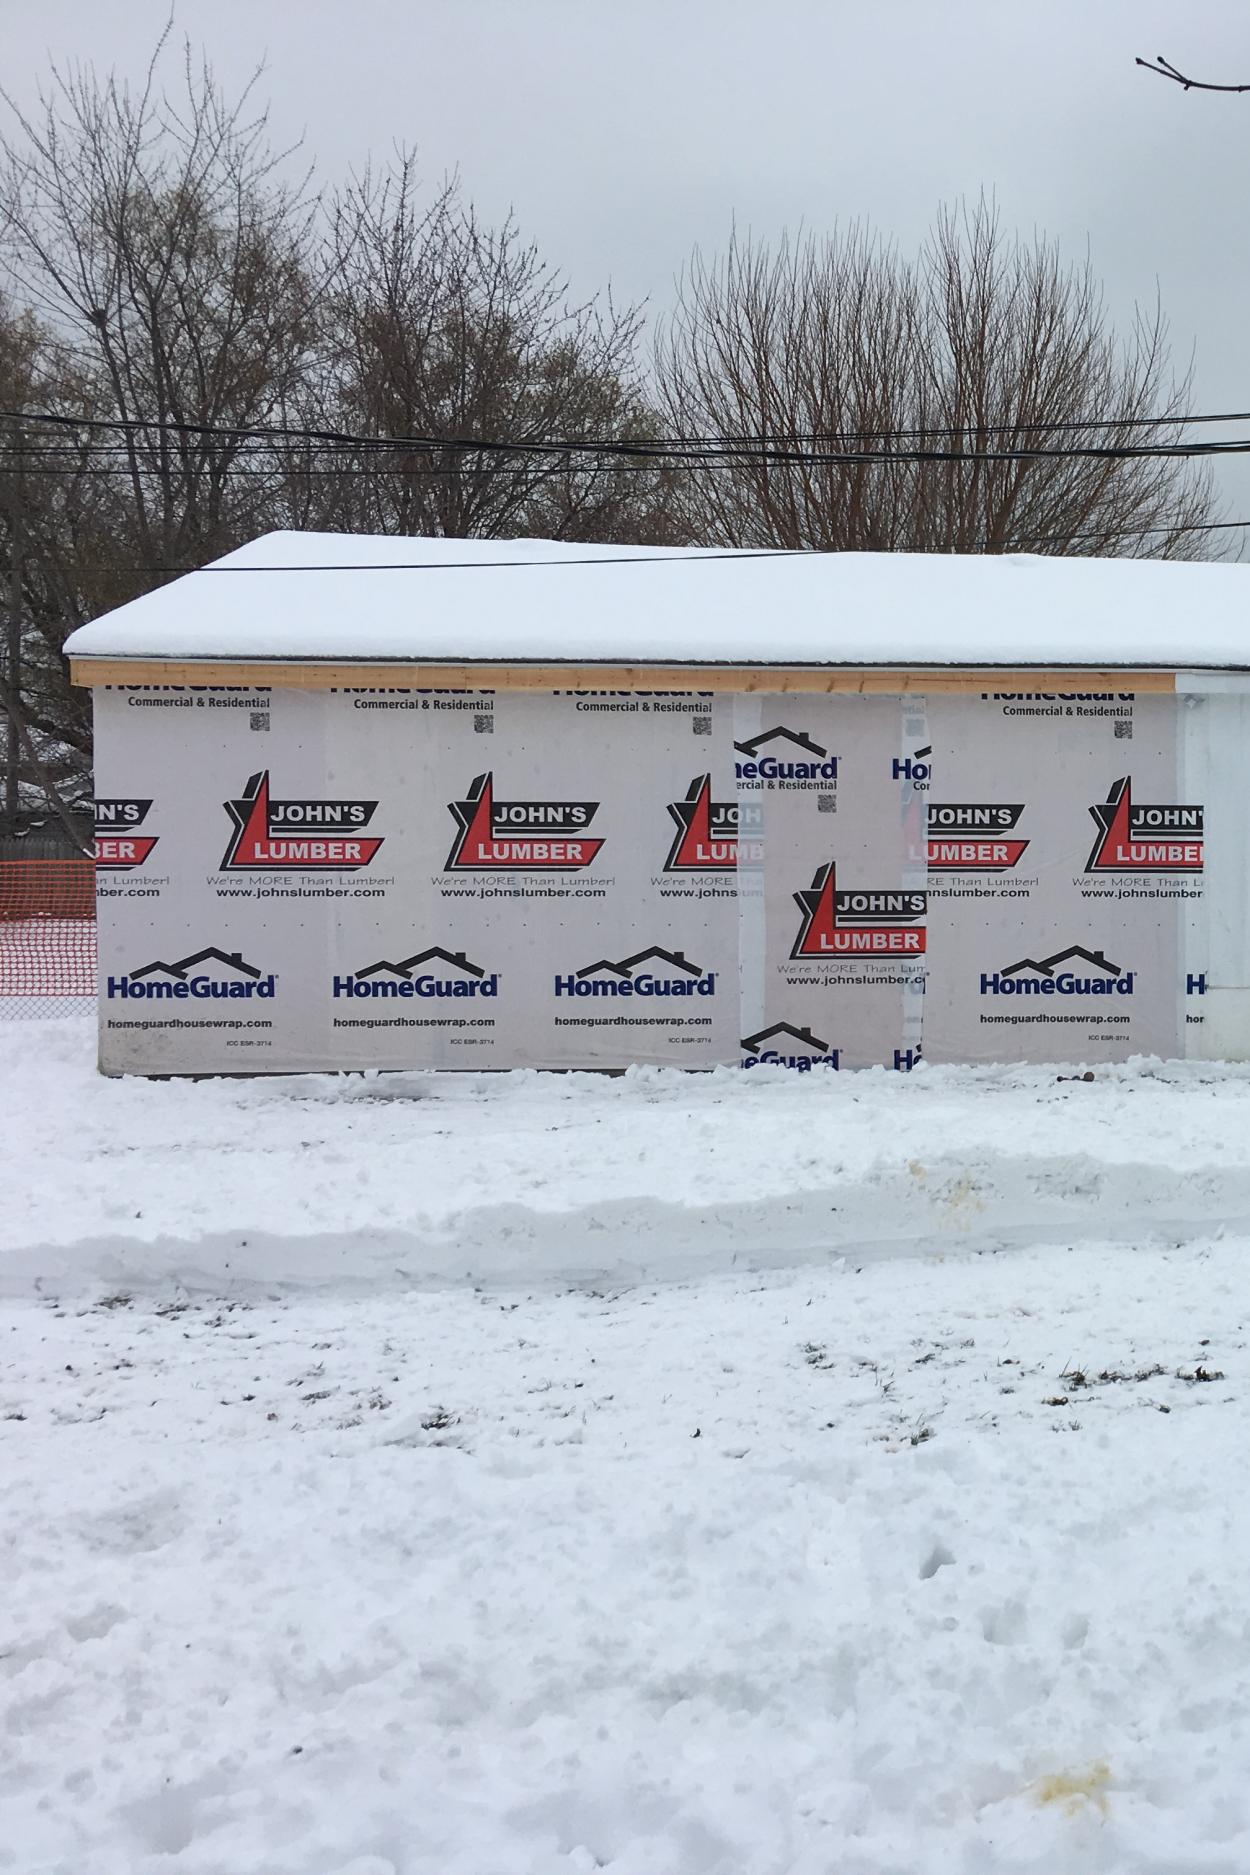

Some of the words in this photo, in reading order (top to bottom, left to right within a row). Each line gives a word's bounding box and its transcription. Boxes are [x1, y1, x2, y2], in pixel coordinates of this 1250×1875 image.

[128, 697, 193, 706] Commercial
[197, 697, 204, 707] &
[209, 697, 269, 707] Residential
[354, 699, 418, 709] Commercial
[422, 700, 429, 709] &
[434, 700, 493, 710] Residential
[576, 702, 638, 711] Commercial
[642, 702, 650, 711] &
[653, 702, 712, 712] Residential
[1003, 706, 1062, 715] Commercial
[1066, 707, 1073, 715] &
[1077, 706, 1132, 716] Residential
[735, 756, 837, 779] eGuard
[893, 757, 931, 780] Ho
[768, 780, 775, 789] &
[779, 780, 836, 789] Residential
[95, 805, 139, 820] N'S
[271, 806, 364, 821] JOHN'S
[494, 807, 586, 822] JOHN'S
[926, 809, 1012, 825] JOHN'S
[255, 843, 361, 859] LUMBER
[479, 844, 582, 859] LUMBER
[1116, 845, 1203, 862] LUMBE
[207, 876, 243, 885] We're
[250, 877, 292, 885] MORE
[299, 877, 332, 885] Than
[431, 877, 467, 885] We're
[473, 877, 516, 885] MORE
[522, 877, 555, 885] Than
[651, 877, 685, 885] We're
[692, 877, 733, 885] MORE
[950, 878, 981, 886] Than
[1072, 878, 1105, 886] We're
[1112, 878, 1150, 886] MORE
[1157, 878, 1187, 886] Than
[217, 888, 384, 899] www.johnslumber.com
[441, 888, 605, 899] www.johnslumber.com
[837, 896, 924, 911] JOHN'S
[821, 933, 919, 949] LUMBER
[818, 964, 857, 973] MORE
[108, 974, 274, 998] HomeGuard
[334, 973, 497, 997] HomeGuard
[555, 972, 714, 996] HomeGuard
[981, 970, 1133, 994] HomeGuard
[108, 1019, 272, 1030] homeguardhousewrap.com
[334, 1018, 495, 1028] homeguardhousewrap.com
[555, 1017, 712, 1027] homeguardhousewrap.com
[980, 1014, 1130, 1024] homeguardhousewrap.com
[741, 1049, 839, 1072] eGuard
